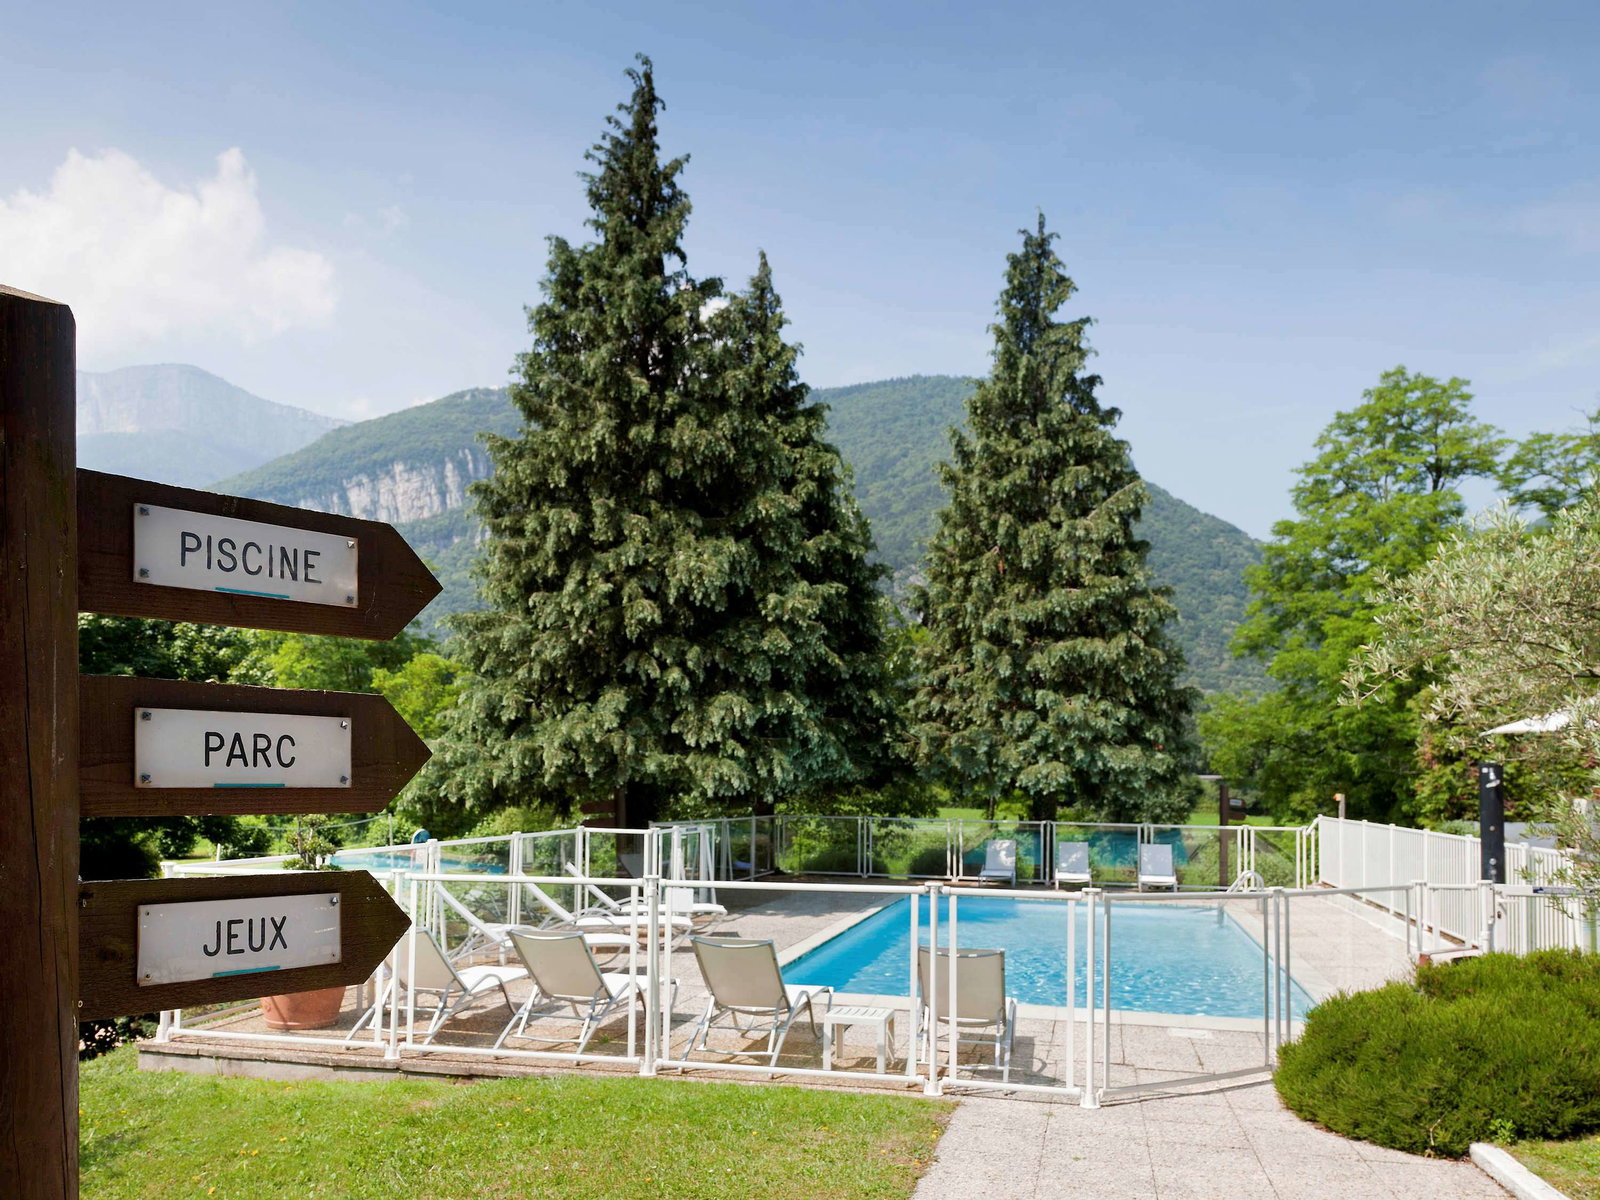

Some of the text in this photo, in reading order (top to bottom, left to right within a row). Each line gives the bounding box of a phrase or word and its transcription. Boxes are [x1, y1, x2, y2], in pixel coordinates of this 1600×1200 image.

[180, 530, 323, 585] PISCINE
[204, 731, 296, 769] PARC
[202, 915, 288, 957] JEUX
